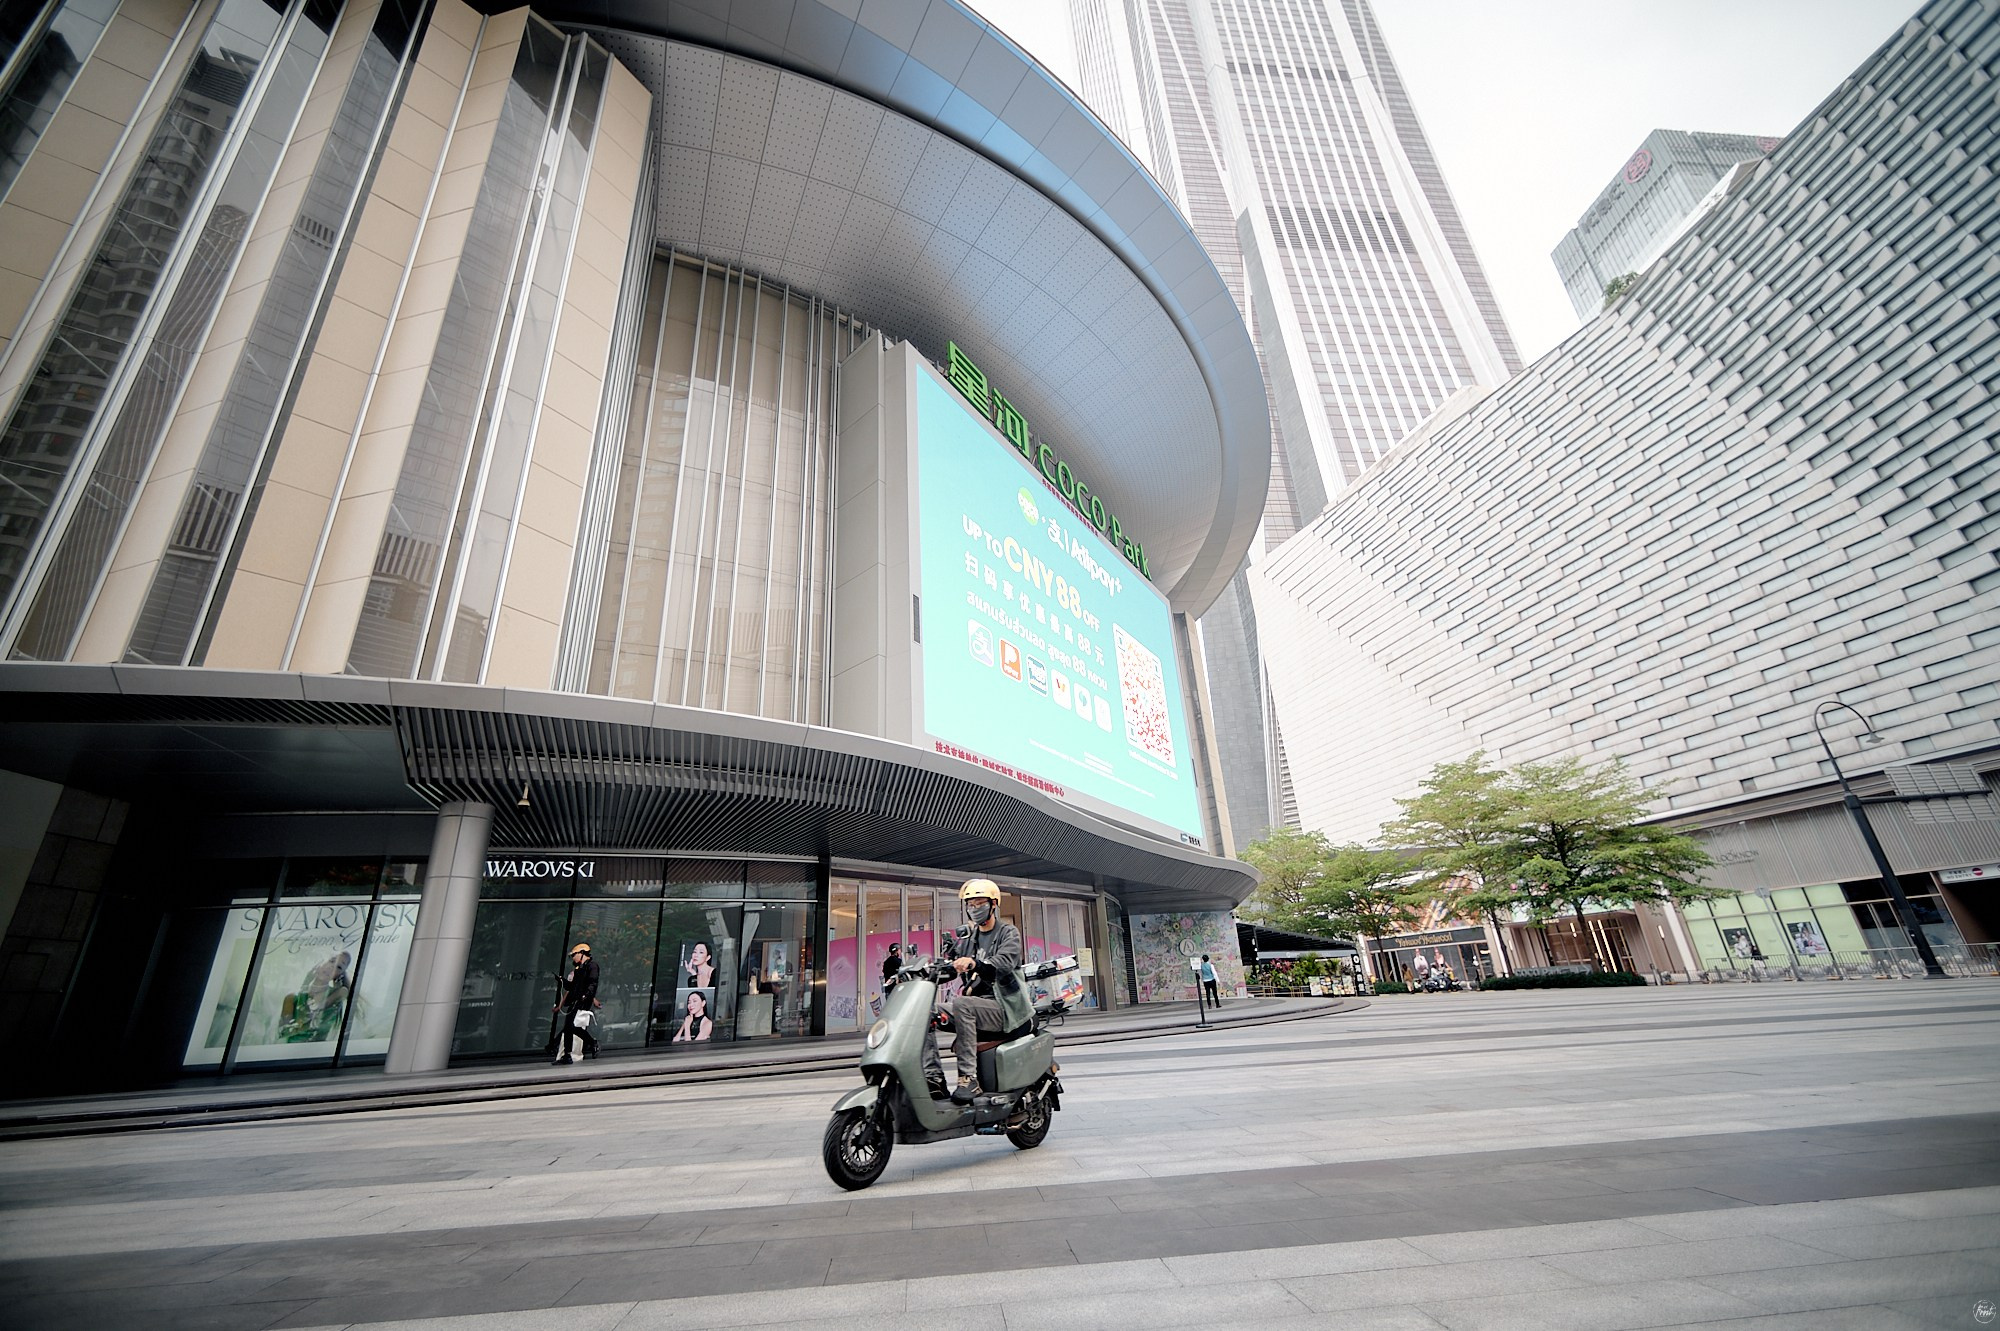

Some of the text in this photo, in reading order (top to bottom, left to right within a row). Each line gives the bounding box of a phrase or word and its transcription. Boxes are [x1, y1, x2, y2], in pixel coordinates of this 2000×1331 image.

[947, 341, 1030, 459] 星河
[1037, 443, 1107, 533] COCO
[1110, 514, 1152, 580] Park
[962, 514, 983, 541] UP
[983, 531, 1004, 558] TO
[1082, 609, 1100, 632] OFF
[1071, 655, 1087, 677] 88
[483, 860, 595, 878] WAROVSKI
[240, 904, 417, 932] SWAROVSK
